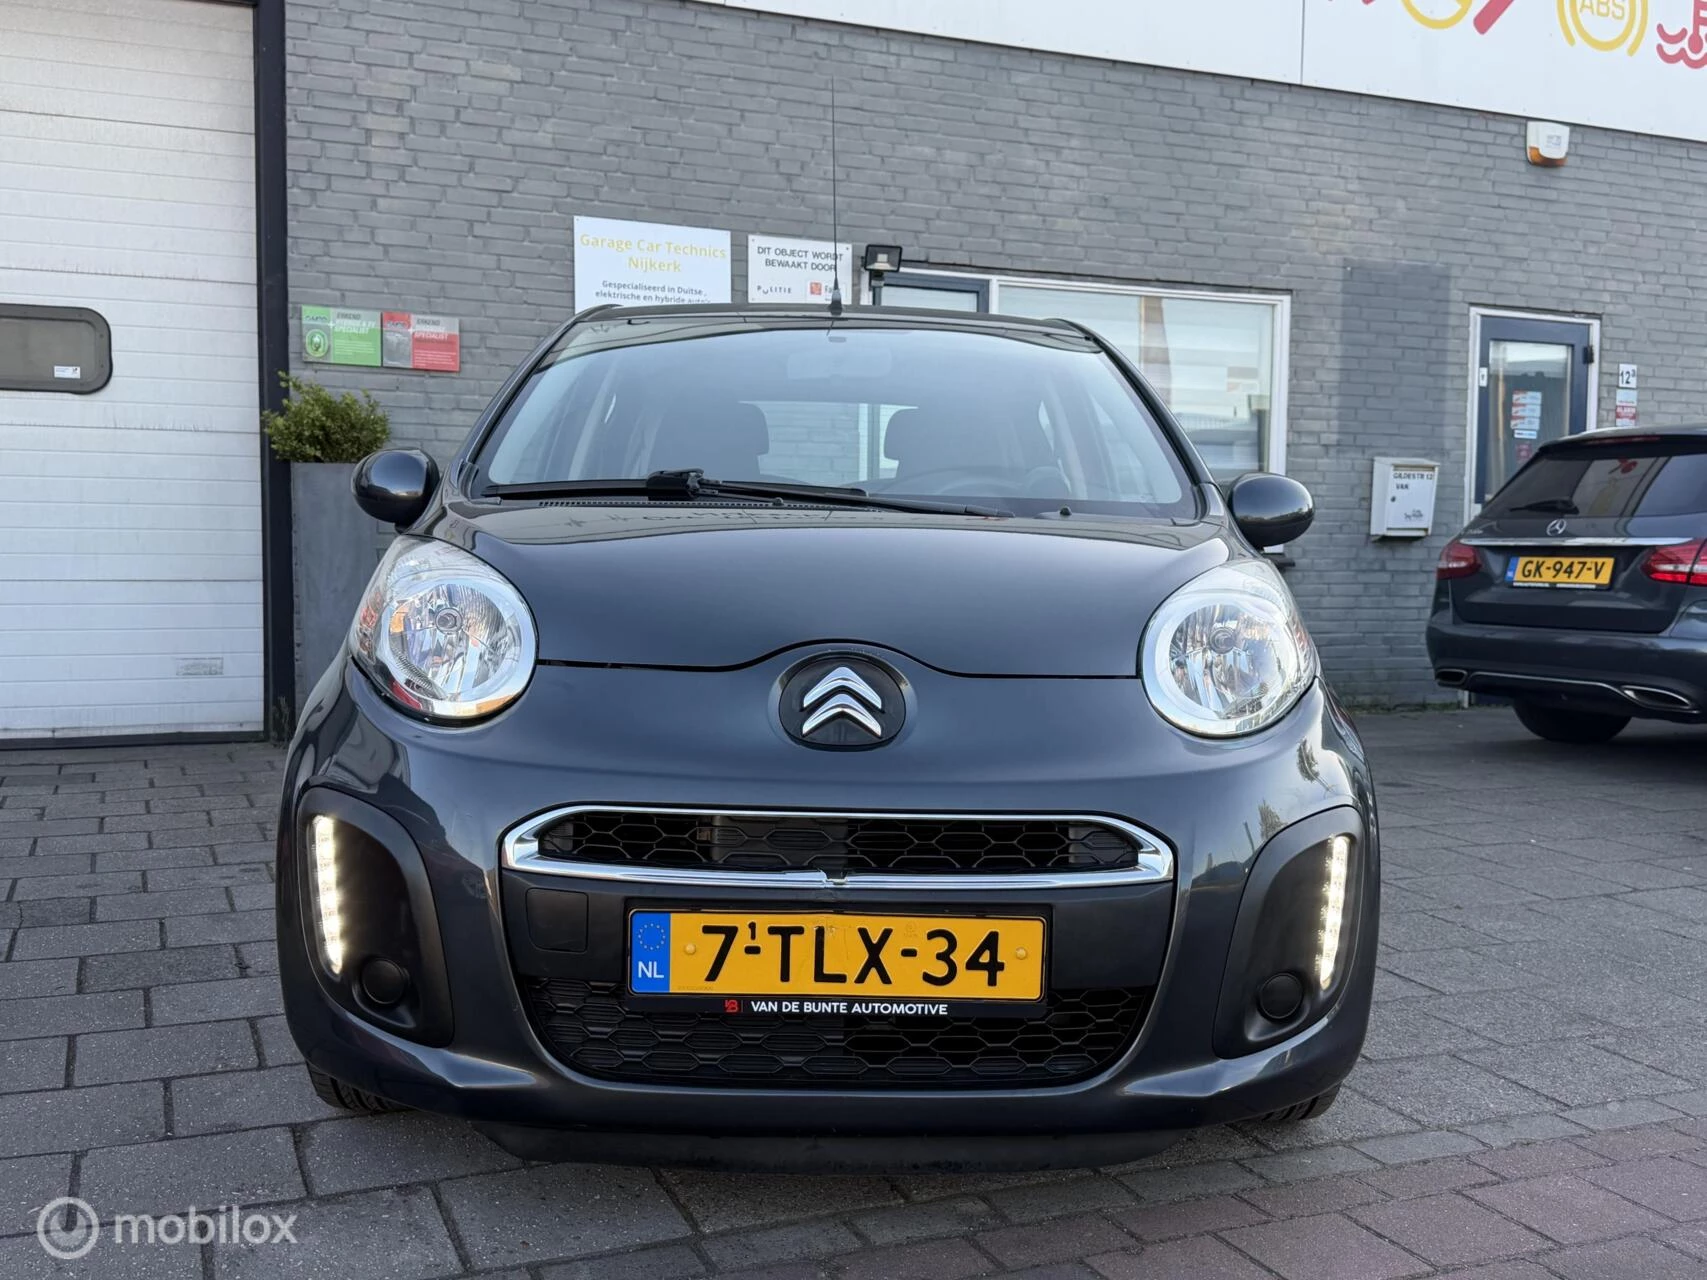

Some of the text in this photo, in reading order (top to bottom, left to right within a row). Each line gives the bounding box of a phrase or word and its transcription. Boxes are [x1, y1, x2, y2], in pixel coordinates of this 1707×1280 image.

[1580, 0, 1625, 20] ABS
[580, 234, 727, 258] Garage Car Technics
[757, 246, 771, 255] DIT
[774, 248, 808, 258] OBJECT
[628, 256, 681, 273] Nijkerk
[765, 258, 808, 270] BEWAAKT
[602, 280, 666, 292] Gespecialiseerd
[668, 285, 676, 293] in
[677, 286, 703, 295] Duitse
[595, 290, 641, 301] elektrische
[655, 294, 686, 304] hybride
[1521, 560, 1605, 579] GK-947-V
[638, 961, 664, 978] NL
[751, 1001, 948, 1015] VAN DE BUNTE AUTOMOTIVE
